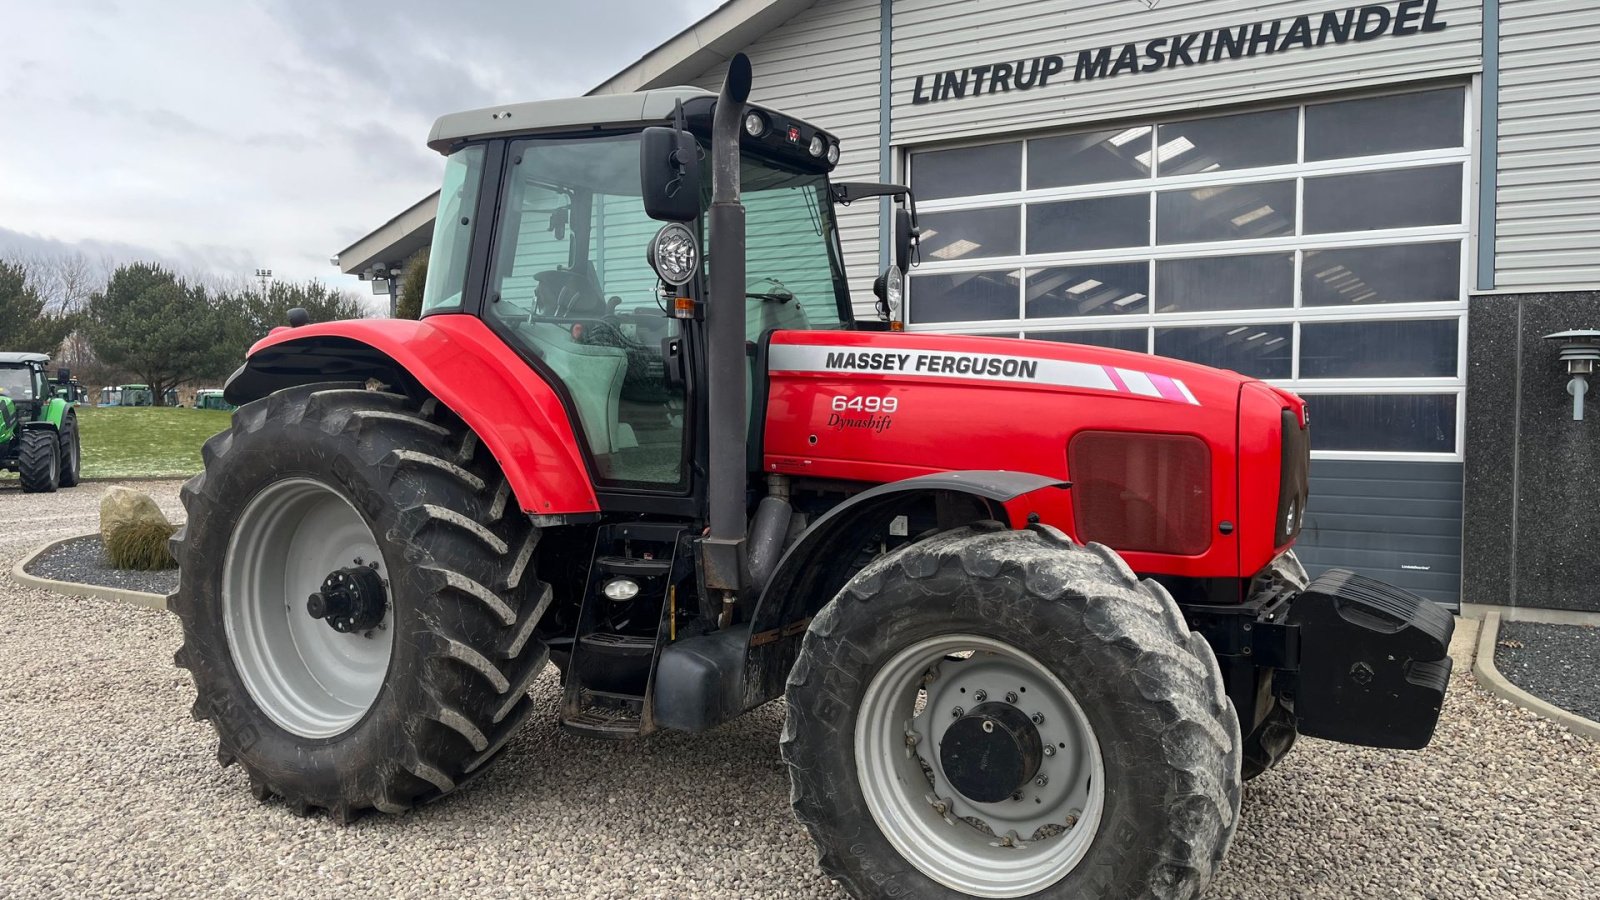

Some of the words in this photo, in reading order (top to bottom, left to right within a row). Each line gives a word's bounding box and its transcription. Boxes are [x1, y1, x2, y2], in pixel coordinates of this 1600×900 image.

[912, 55, 1063, 105] LINTRUP
[1073, 0, 1447, 81] MASKINHANDEL
[826, 352, 909, 370] MASSEY
[915, 355, 1037, 378] FERGUSON
[832, 395, 898, 413] 6499
[827, 413, 892, 433] Dynashift
